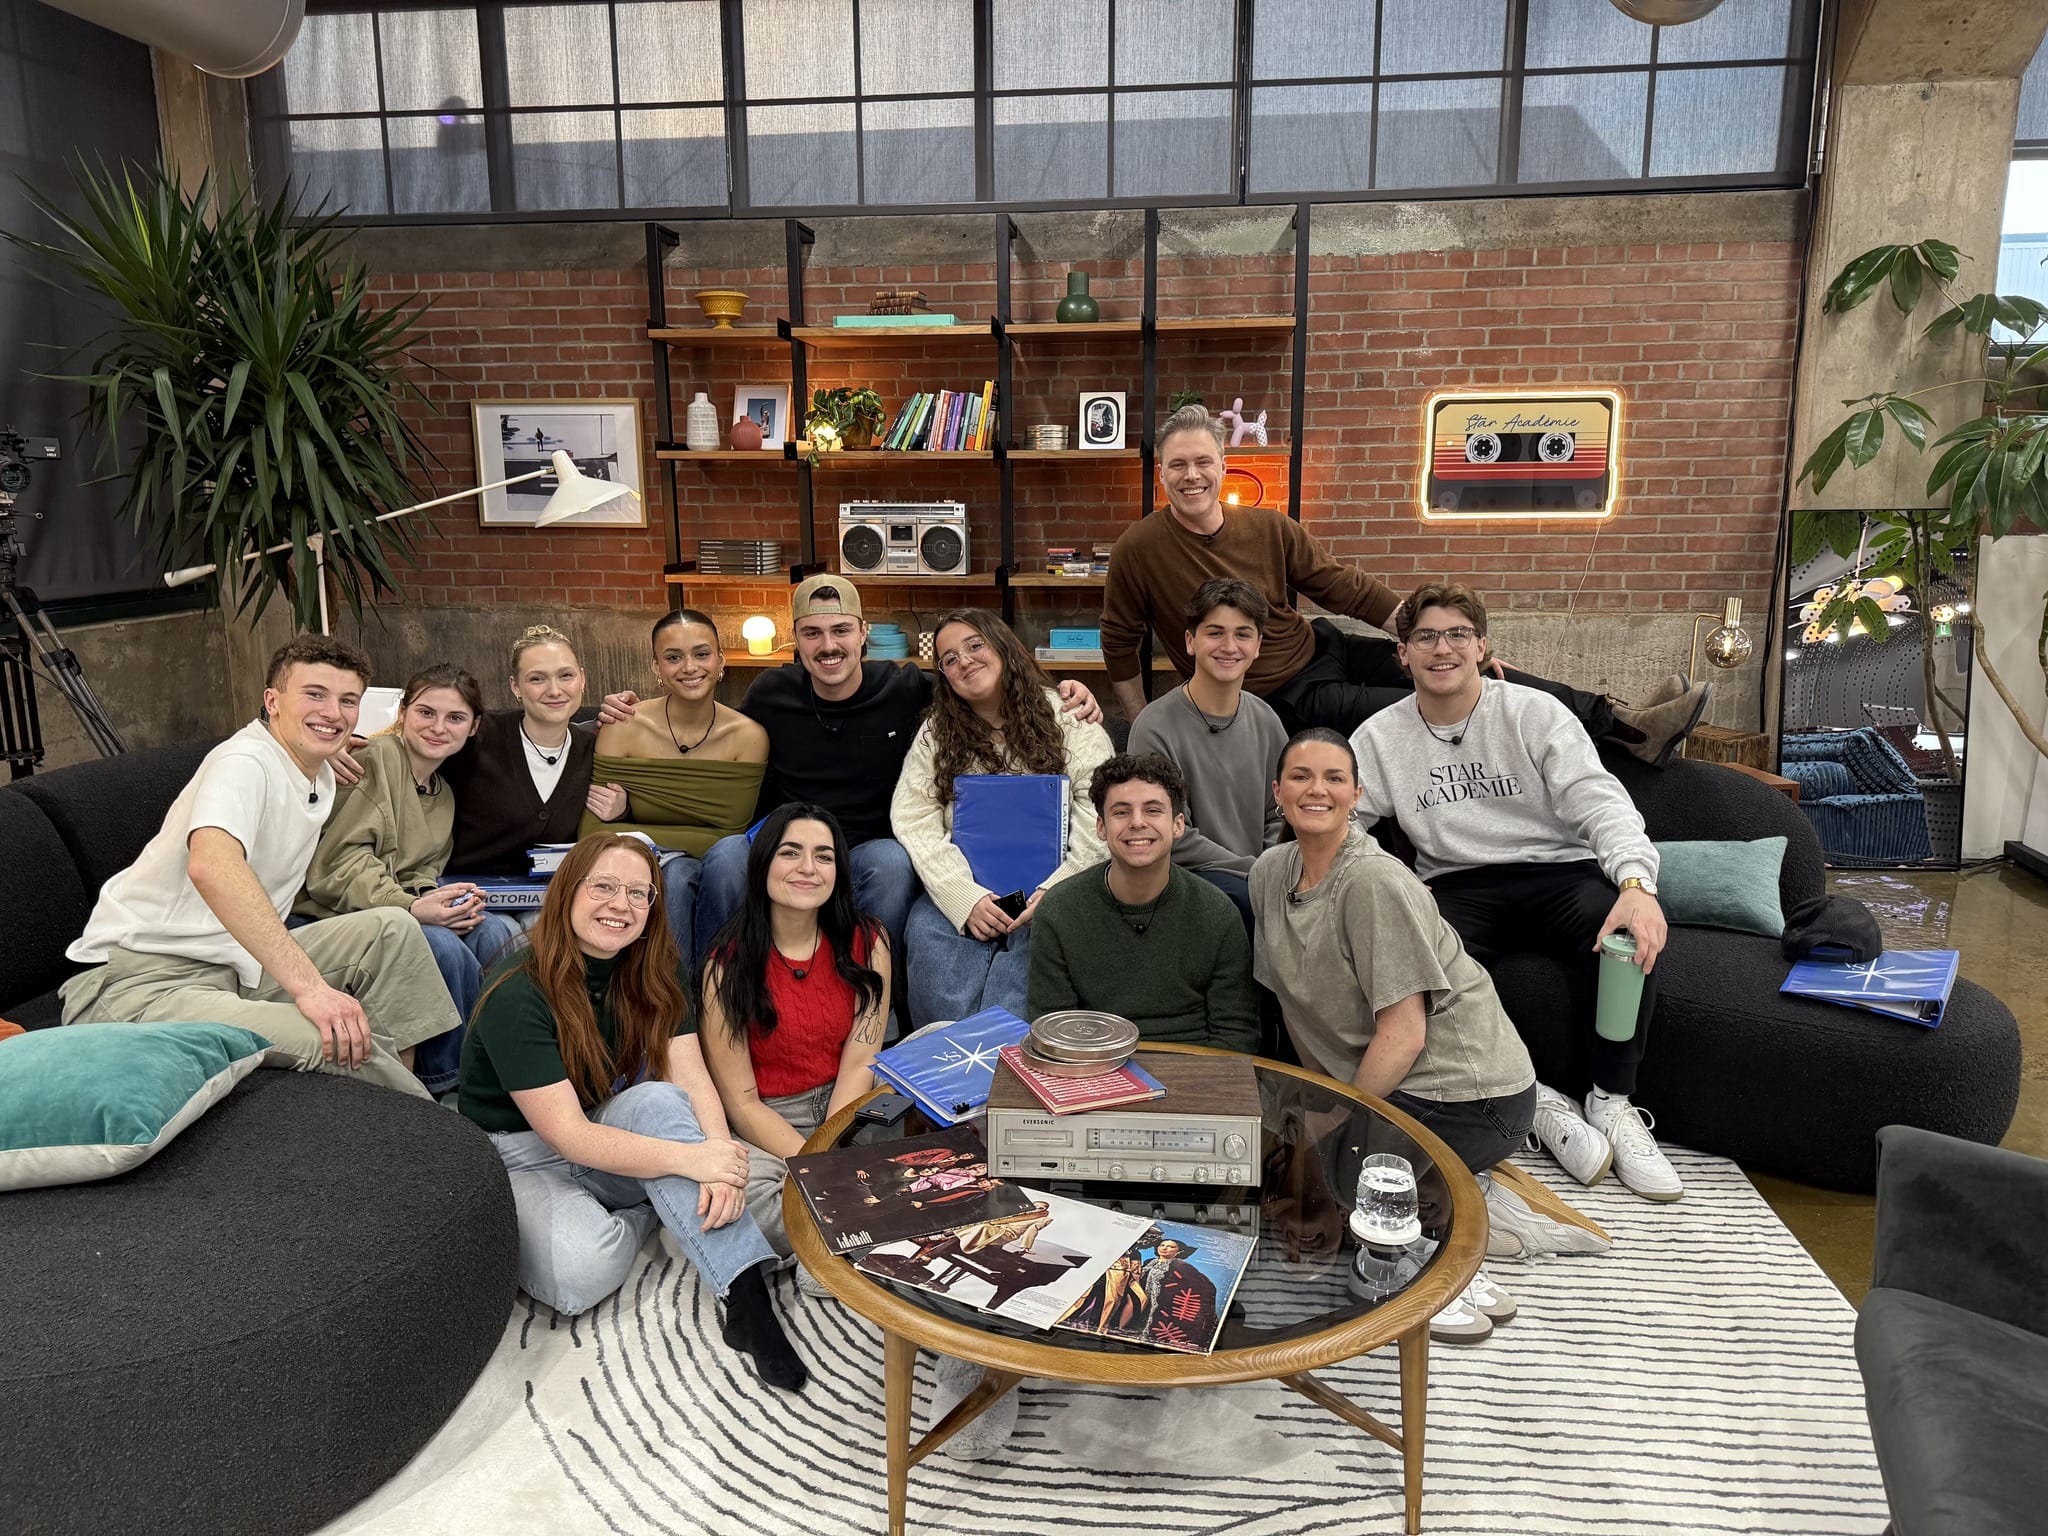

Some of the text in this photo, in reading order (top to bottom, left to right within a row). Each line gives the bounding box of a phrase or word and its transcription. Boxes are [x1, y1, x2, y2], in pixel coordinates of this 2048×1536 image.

[1465, 413, 1580, 432] Star Académie
[1429, 762, 1486, 785] STAR
[485, 894, 540, 903] ICTORIA
